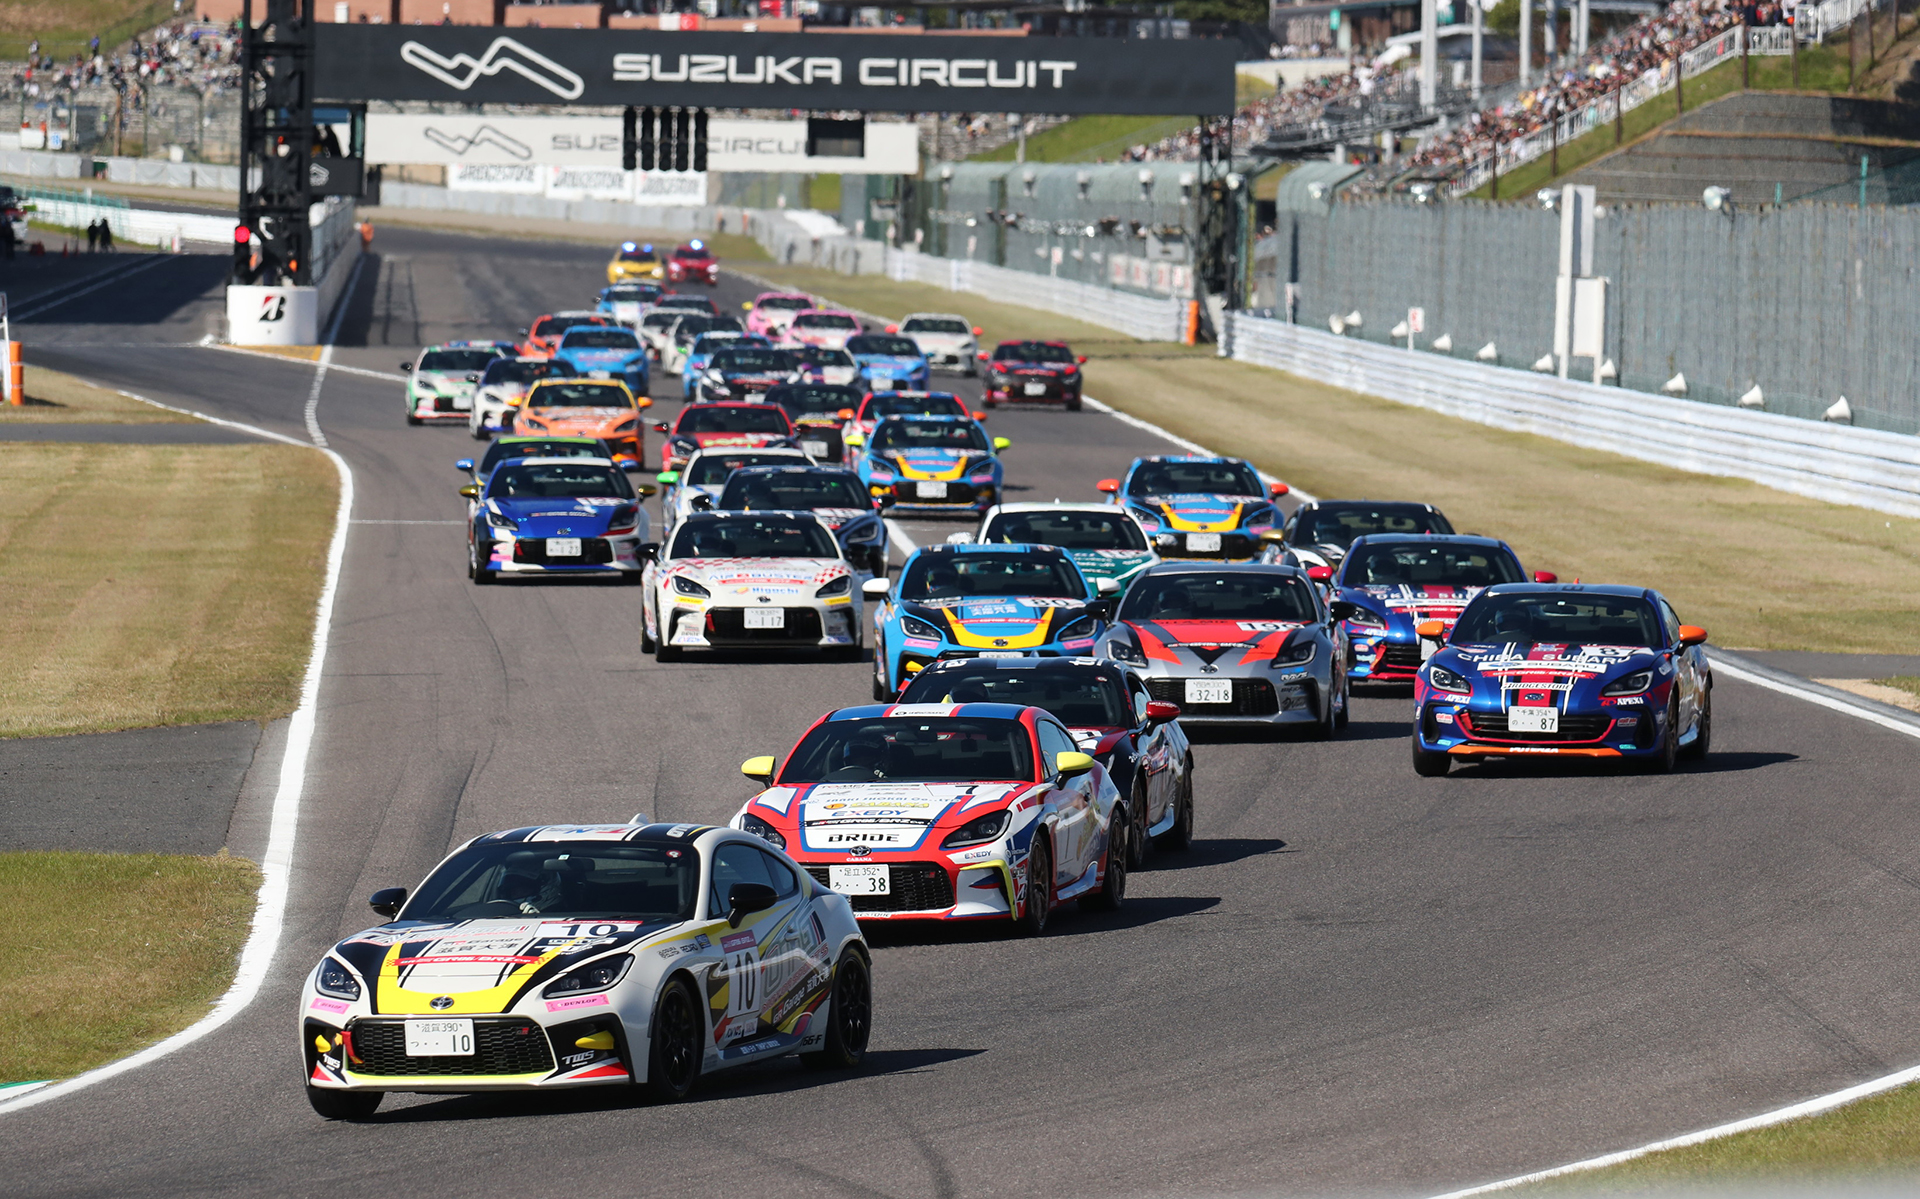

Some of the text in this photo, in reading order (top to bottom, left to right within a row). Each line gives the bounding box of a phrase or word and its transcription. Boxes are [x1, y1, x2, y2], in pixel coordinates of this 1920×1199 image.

[613, 53, 1077, 88] SUZUKA CIRCUIT
[707, 136, 802, 154] CIRCU
[1457, 653, 1631, 665] CHIBA SUBARU
[1540, 718, 1556, 730] 87
[831, 809, 909, 817] EXEDY
[828, 833, 900, 843] BRIDE
[964, 850, 992, 860] EXEDY
[868, 877, 887, 892] 38
[562, 924, 619, 937] 10
[735, 951, 755, 1011] 10
[564, 998, 598, 1007] DUNLOP
[452, 1034, 471, 1053] 10
[562, 1050, 595, 1065] TWS
